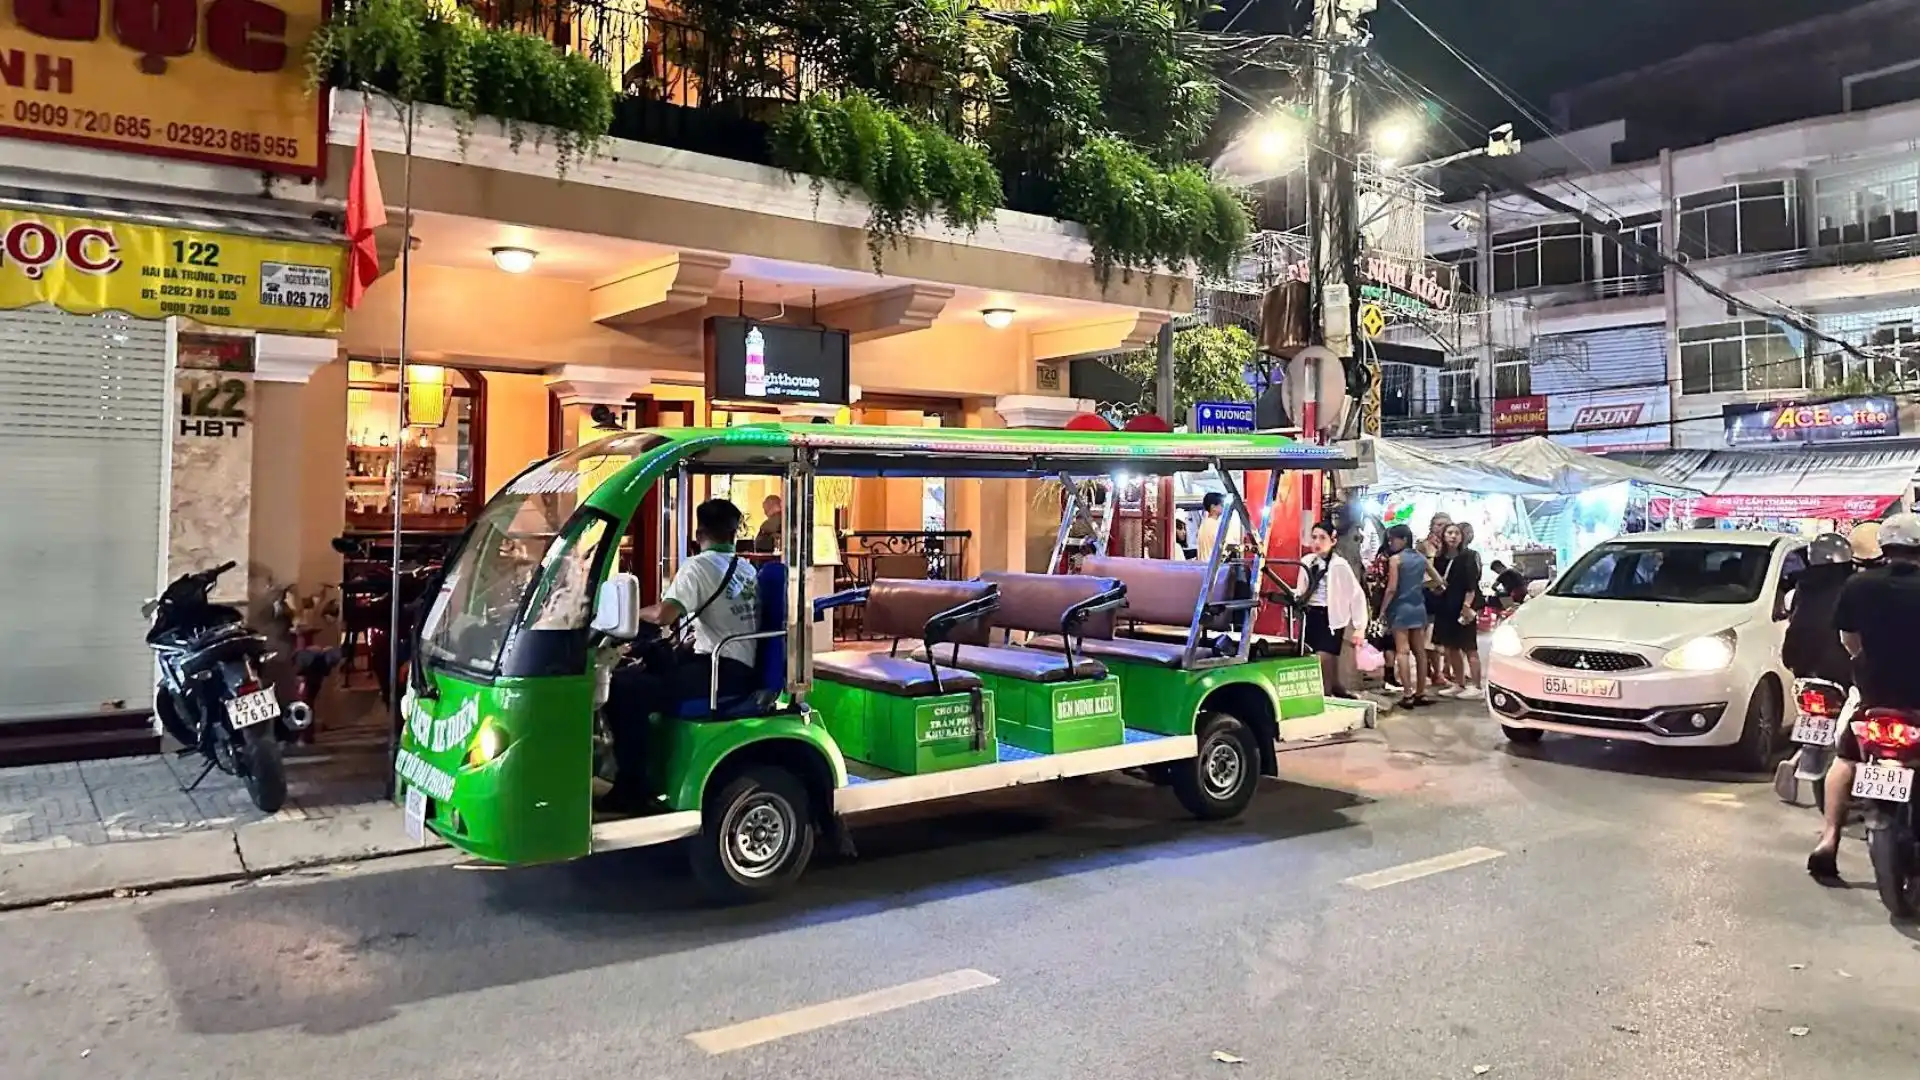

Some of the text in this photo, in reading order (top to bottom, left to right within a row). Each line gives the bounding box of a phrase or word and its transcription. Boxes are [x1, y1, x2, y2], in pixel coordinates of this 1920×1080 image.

[14, 100, 68, 127] 0909
[73, 108, 111, 133] 720
[114, 114, 151, 139] 685
[166, 122, 227, 149] 02923
[230, 131, 261, 154] 815
[263, 137, 298, 159] 955
[0, 222, 122, 280] ỌC
[172, 240, 219, 267] 122
[142, 265, 159, 278] HAI
[221, 273, 247, 286] TPCT
[287, 290, 306, 305] 026
[310, 292, 329, 307] 728
[1040, 367, 1057, 381] 120
[180, 378, 246, 418] 122
[1832, 408, 1888, 425] coffee
[181, 420, 245, 437] HBT
